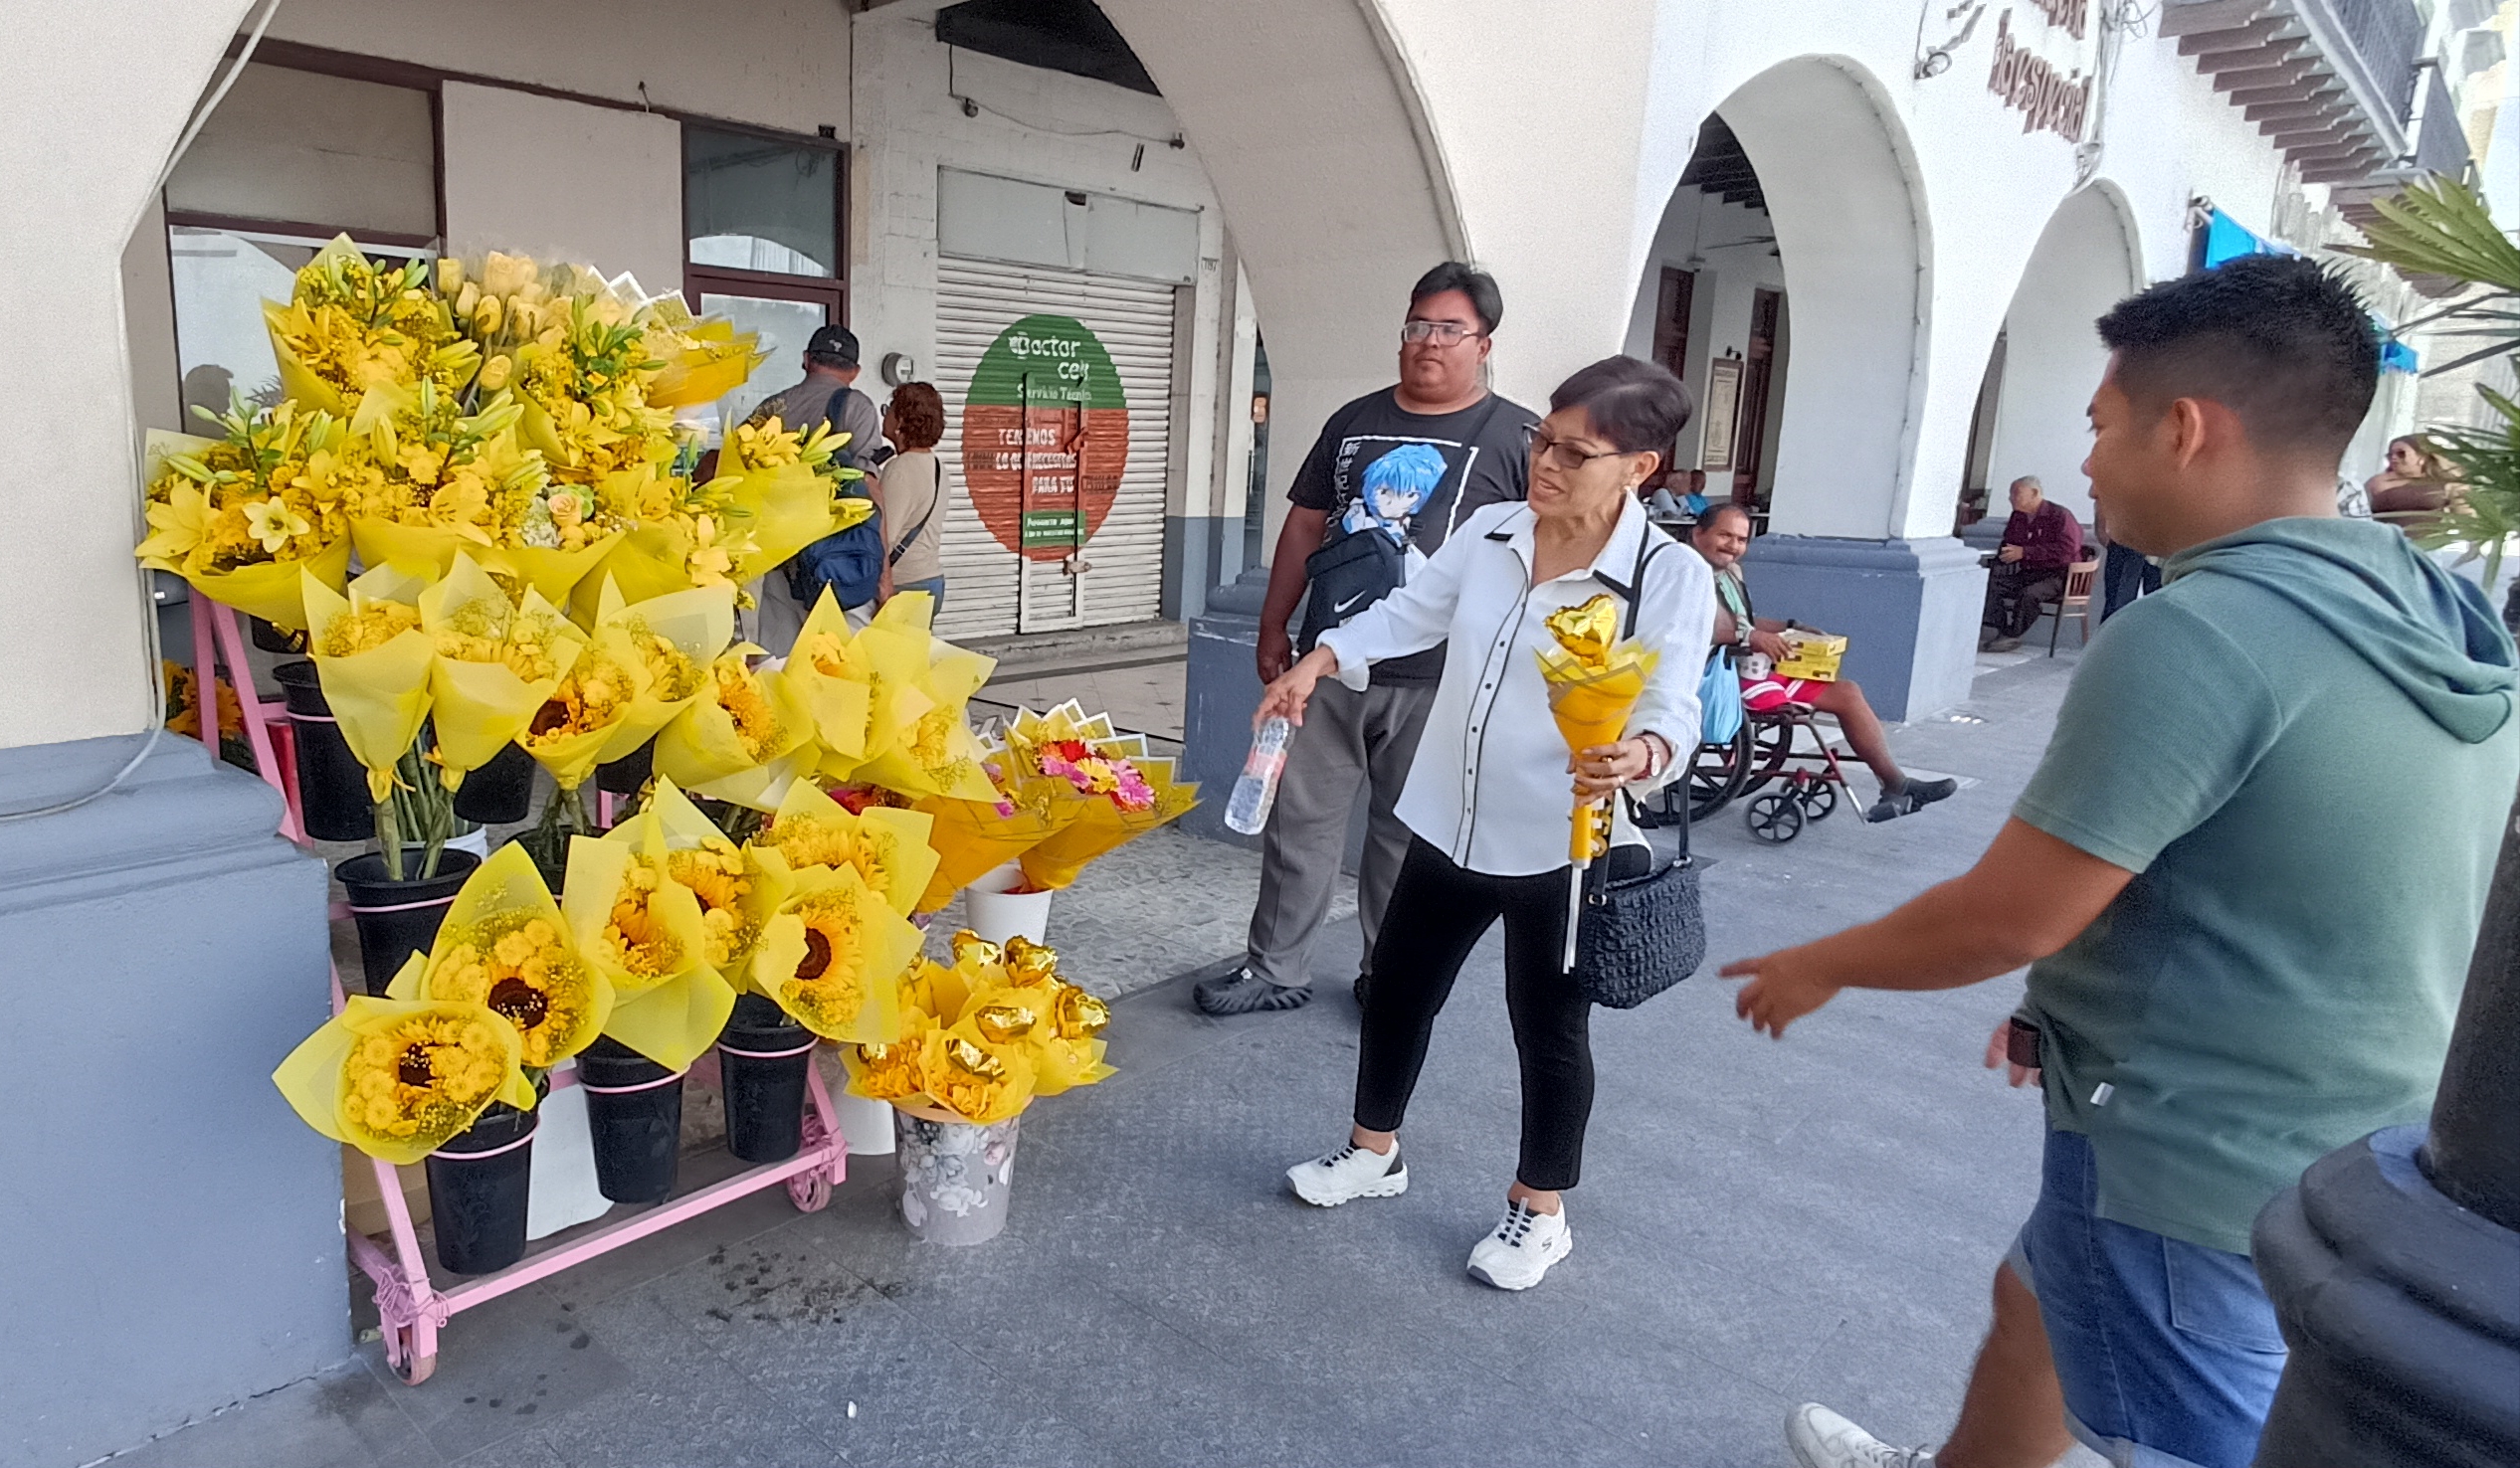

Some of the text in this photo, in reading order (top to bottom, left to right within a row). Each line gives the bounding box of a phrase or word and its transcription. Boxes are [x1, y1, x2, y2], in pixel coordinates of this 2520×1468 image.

[998, 428, 1057, 447] TENEMOS
[996, 452, 1009, 470] LO
[1032, 475, 1059, 494] PARA
